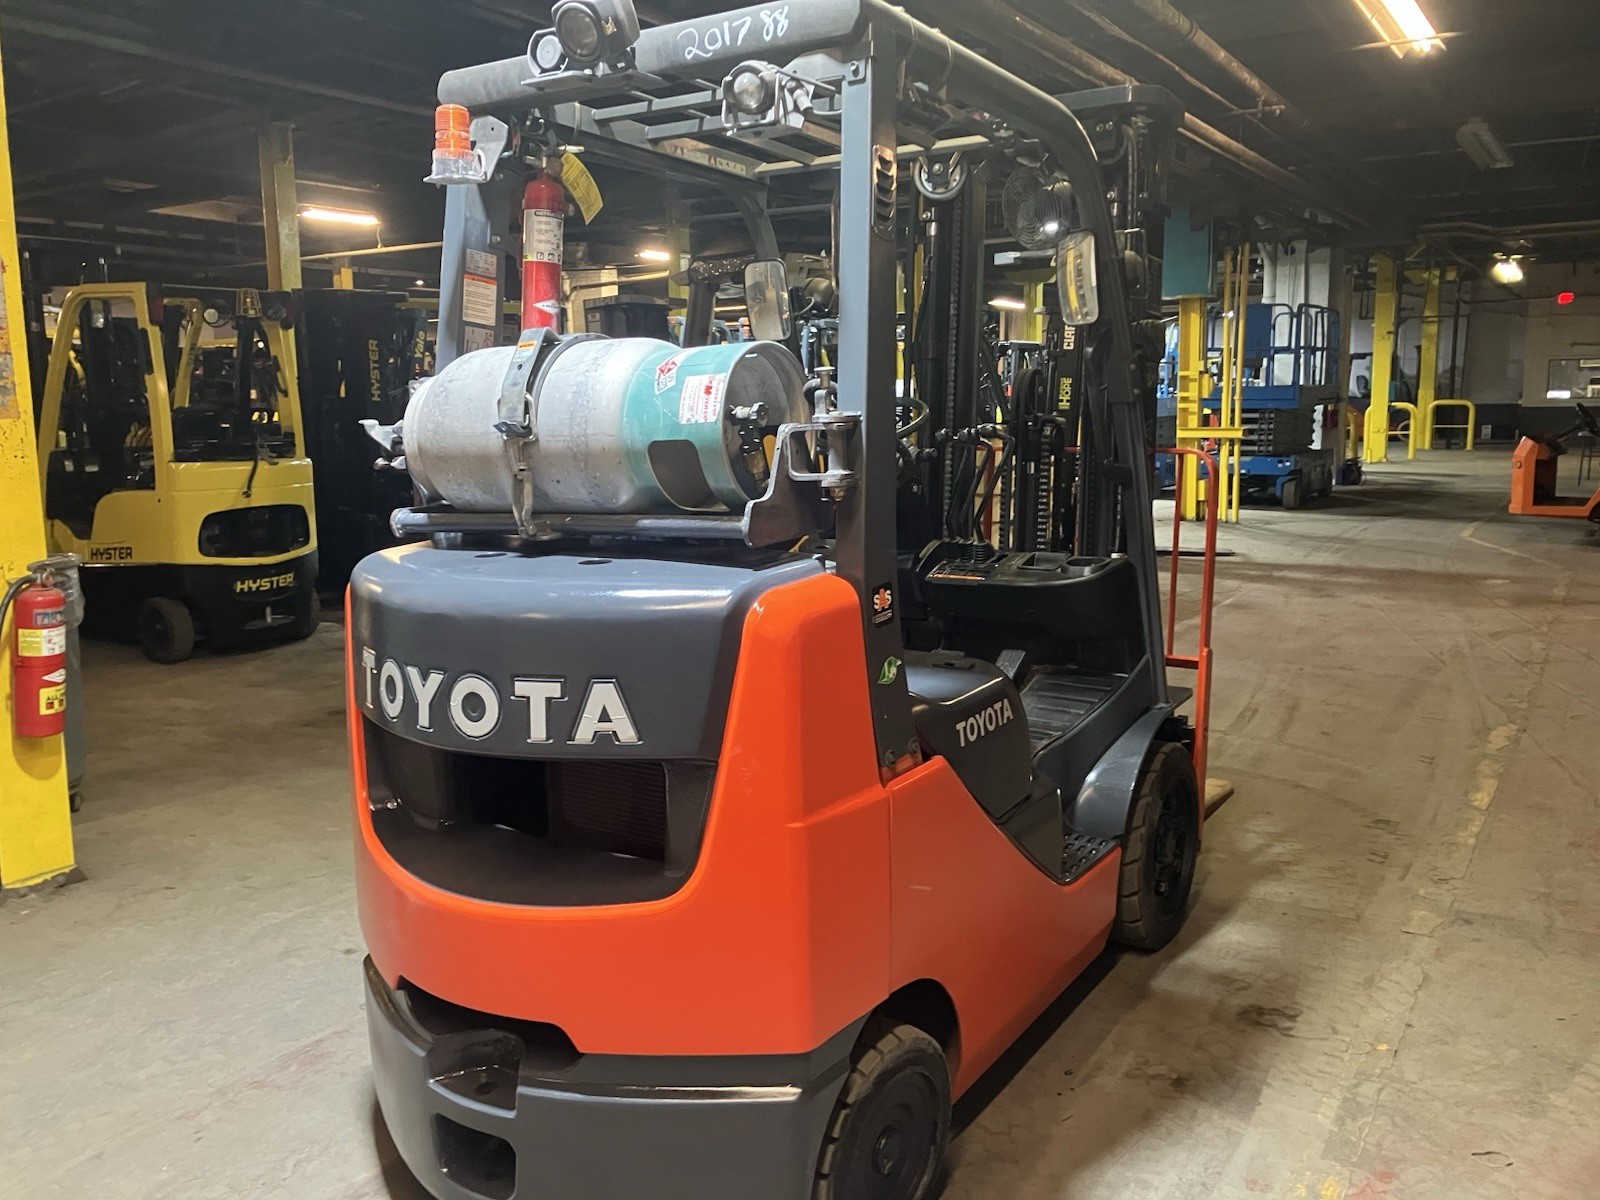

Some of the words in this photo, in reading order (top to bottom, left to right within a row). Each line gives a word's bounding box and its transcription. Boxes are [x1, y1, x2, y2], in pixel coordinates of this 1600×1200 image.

[677, 16, 752, 60] 2017
[760, 5, 789, 41] 88
[414, 330, 426, 358] Yale
[368, 339, 381, 402] HYSTER
[90, 546, 132, 561] HYSTER
[235, 572, 294, 593] HYSTER
[360, 645, 644, 745] TOYOTA
[955, 697, 1014, 748] TOYOTA
